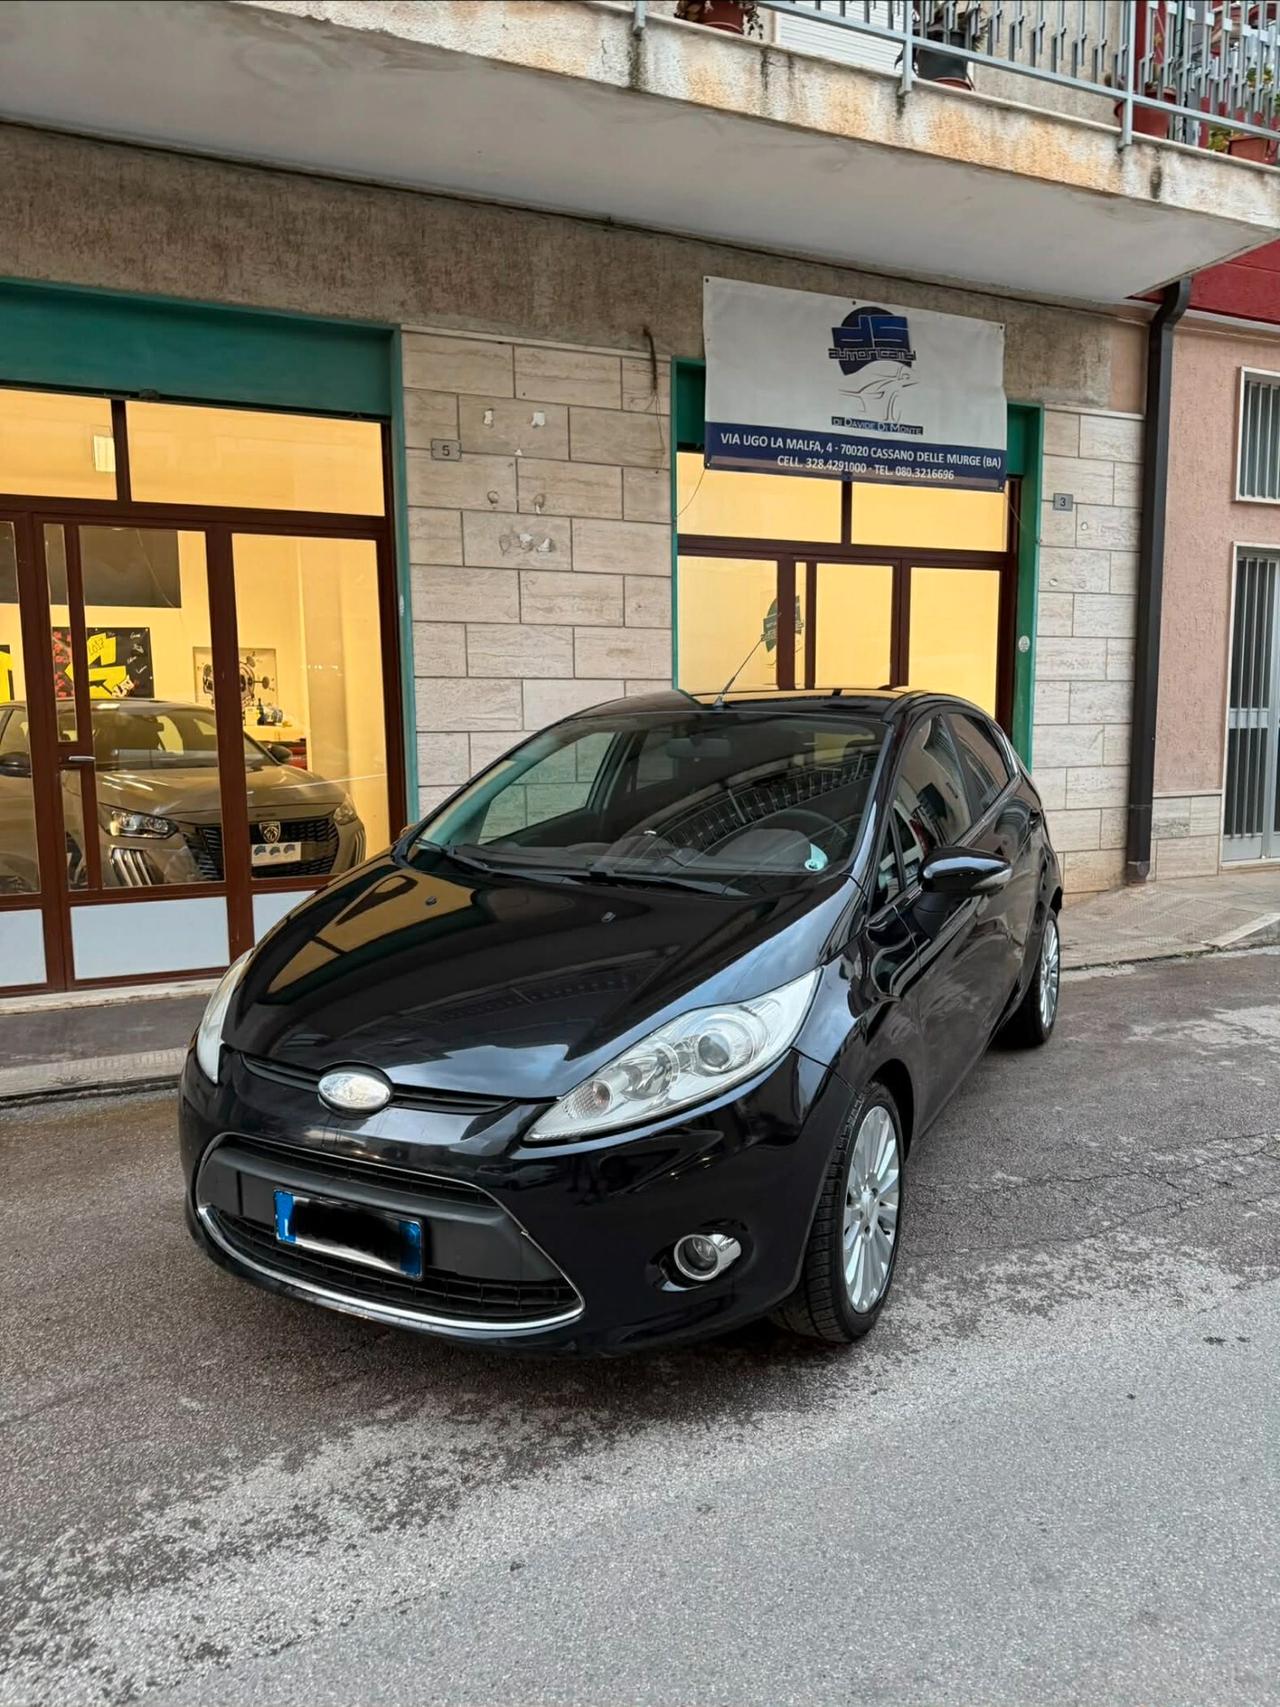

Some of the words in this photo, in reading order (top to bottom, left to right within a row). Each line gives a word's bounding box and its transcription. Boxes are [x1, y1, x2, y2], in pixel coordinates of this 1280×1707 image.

[442, 444, 450, 457] 5
[720, 432, 741, 446] VIA
[743, 434, 768, 447] UGO
[770, 437, 784, 449] LA
[786, 438, 824, 454] MALFA,
[826, 442, 833, 453] 4
[841, 444, 869, 457] 70020
[870, 446, 914, 461] CASSANO
[917, 451, 945, 464] DELLE
[947, 453, 981, 467] MURGE
[982, 455, 1002, 470] (BA)
[777, 455, 803, 468] CELL.
[805, 457, 867, 473] 328.4291000
[874, 463, 893, 477] TEL.
[895, 465, 955, 480] 080.3216696
[1060, 496, 1066, 507] 3
